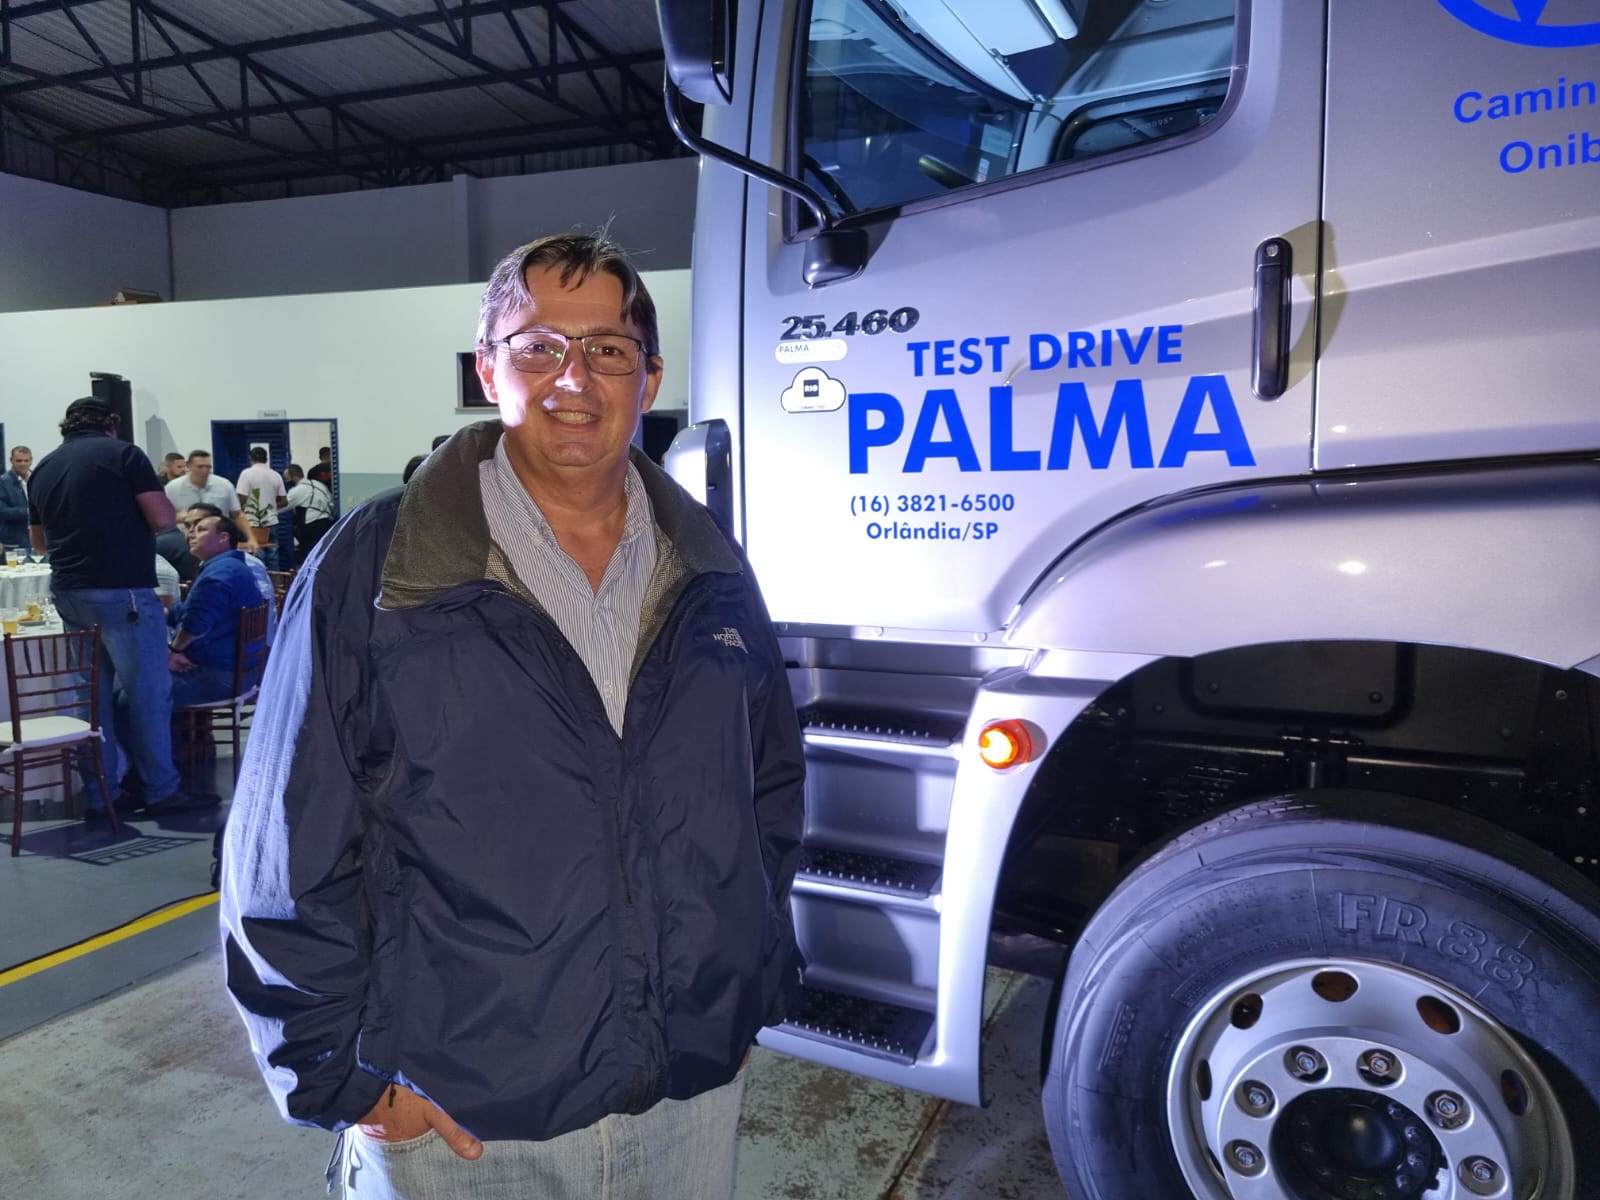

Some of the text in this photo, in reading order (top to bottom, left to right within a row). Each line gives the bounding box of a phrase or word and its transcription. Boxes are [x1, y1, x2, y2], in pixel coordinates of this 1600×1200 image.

[1454, 76, 1596, 124] Camin
[780, 306, 920, 341] 25.460
[779, 344, 810, 353] PALMA
[906, 324, 1182, 377] TEST DRIVE
[848, 374, 1257, 474] PALMA
[851, 493, 1015, 517] (16) 3821-6500
[866, 521, 999, 542] Orlândia/SP
[1338, 891, 1535, 990] FR 88
